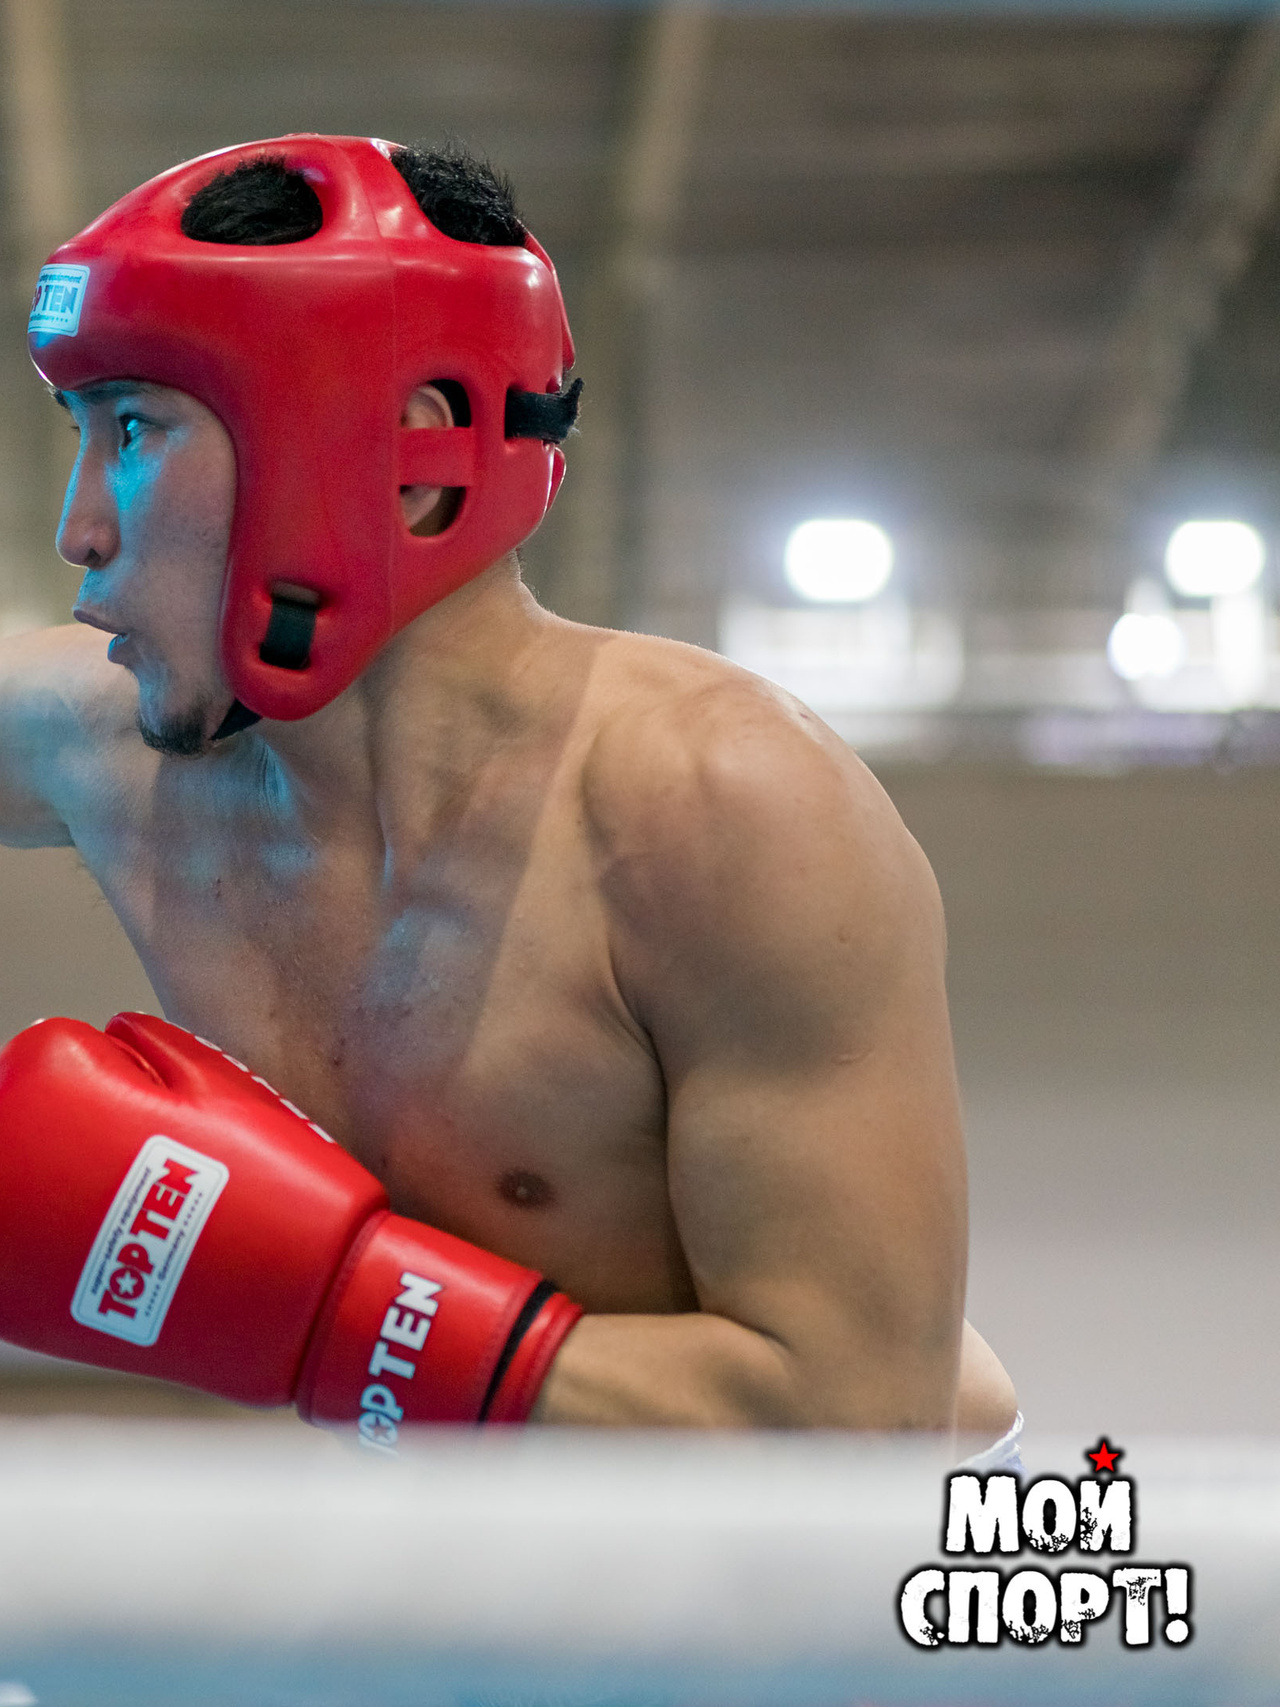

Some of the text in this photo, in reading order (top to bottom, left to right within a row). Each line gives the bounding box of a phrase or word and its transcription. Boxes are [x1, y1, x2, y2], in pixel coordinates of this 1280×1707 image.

[97, 1157, 200, 1320] TOP TEN
[157, 1228, 186, 1281] Germany
[367, 1271, 443, 1380] TEN
